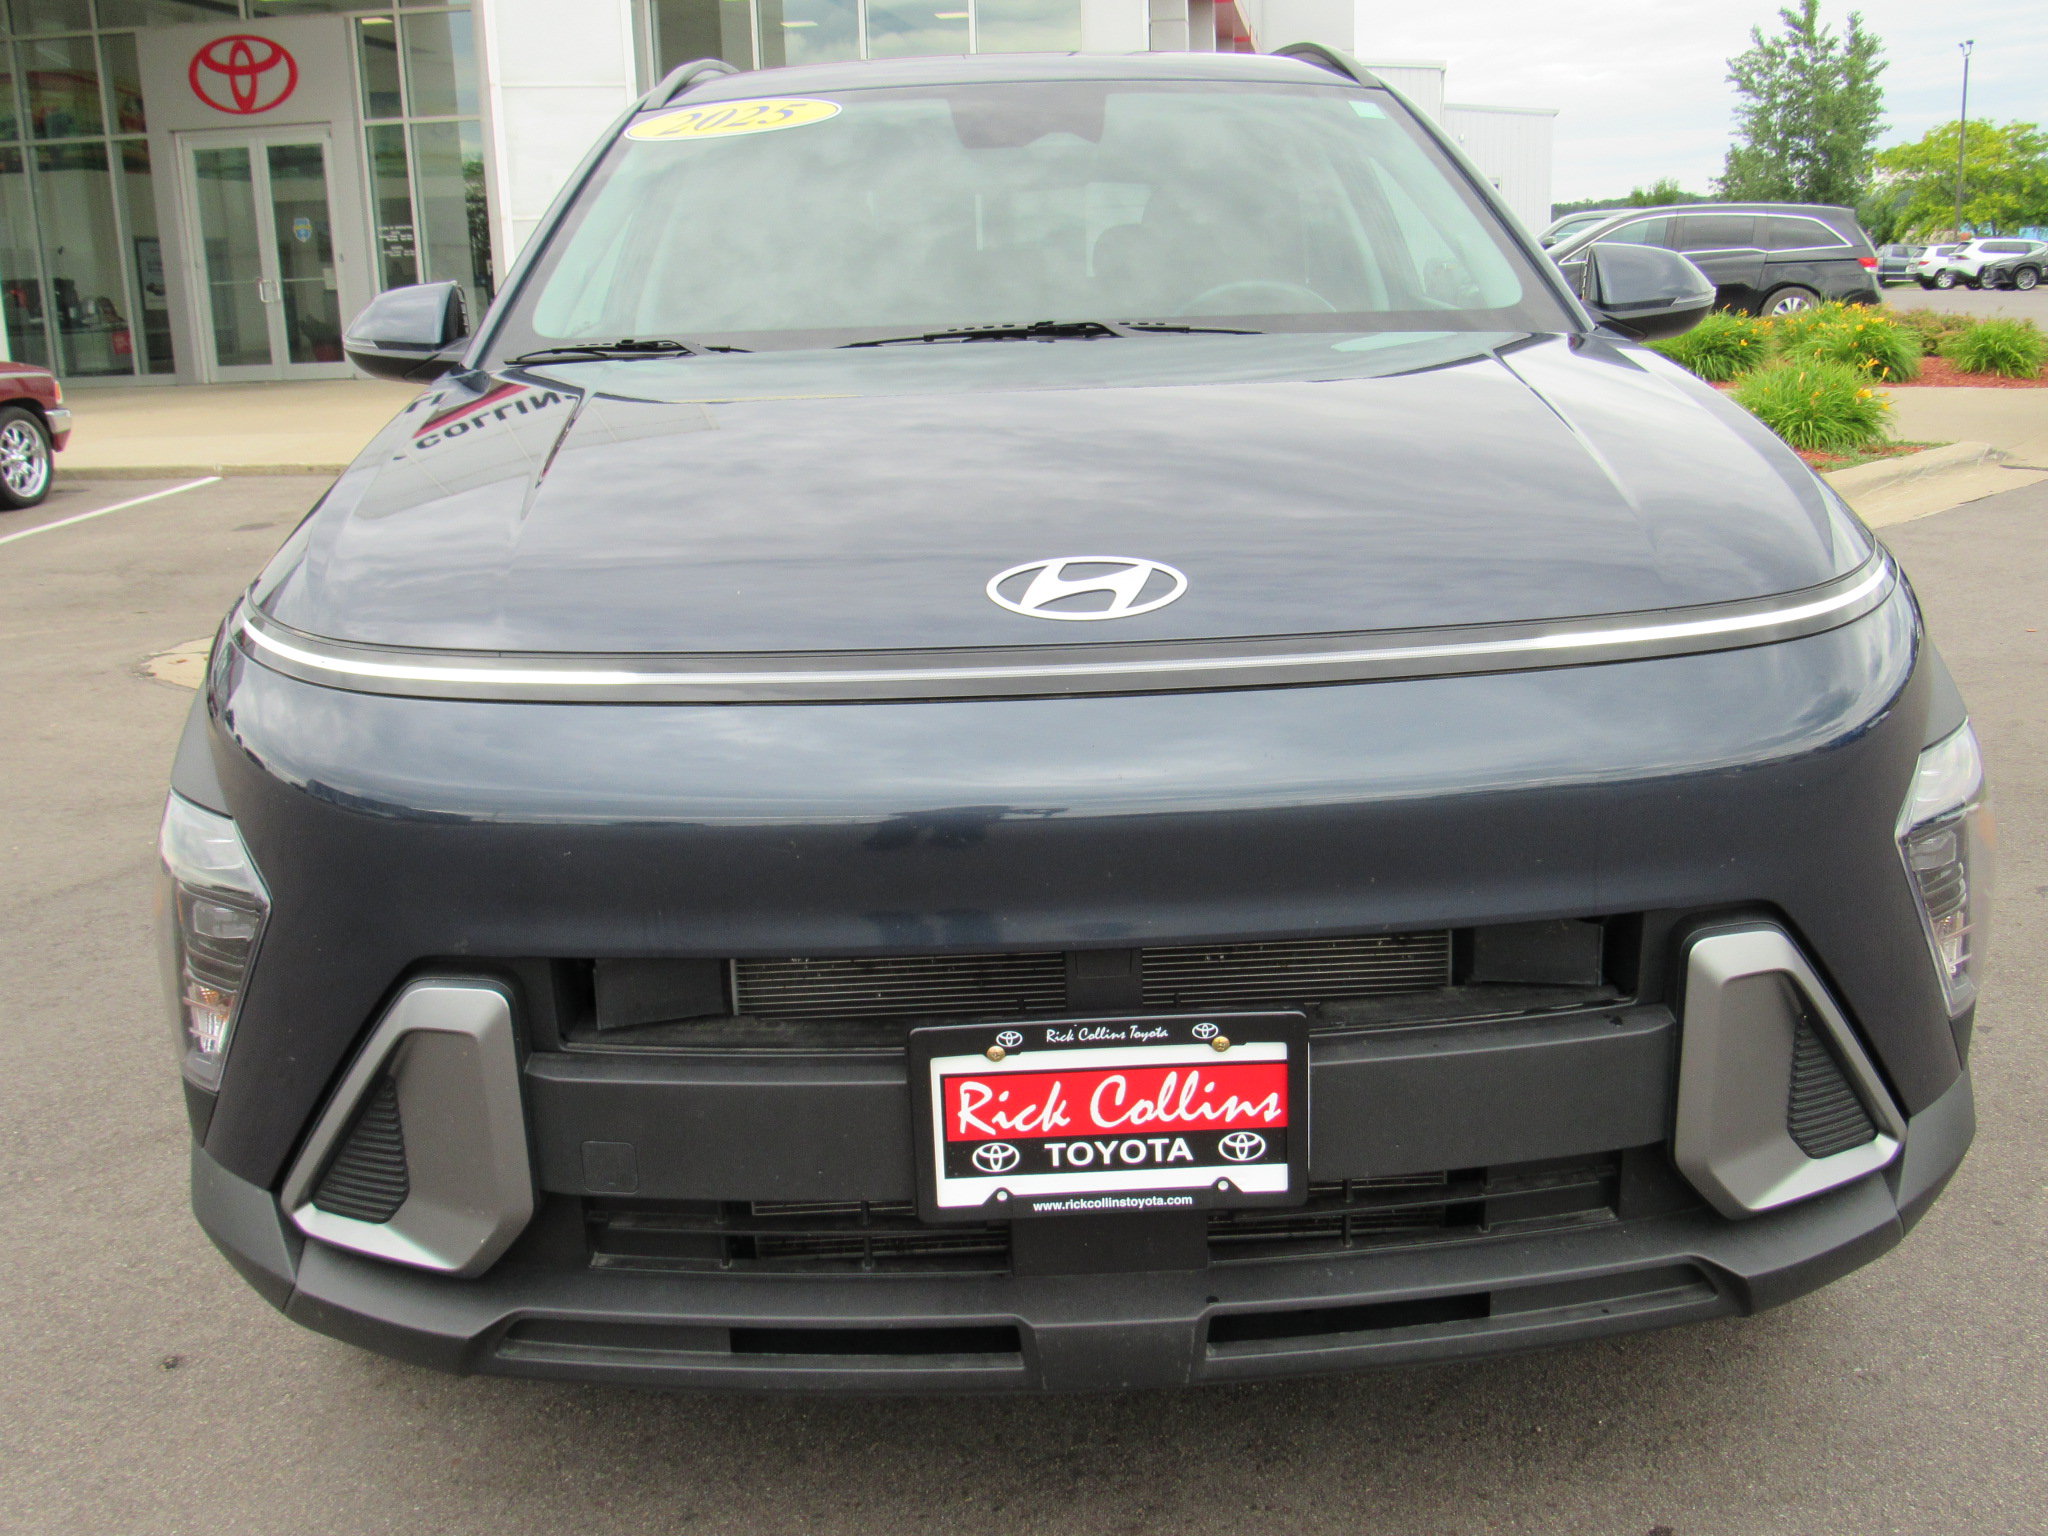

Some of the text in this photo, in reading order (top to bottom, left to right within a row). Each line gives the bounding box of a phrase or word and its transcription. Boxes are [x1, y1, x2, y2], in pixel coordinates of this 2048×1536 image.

[654, 104, 808, 137] 2025
[1046, 1024, 1169, 1043] Rick Collins Toyota
[958, 1069, 1281, 1136] Rick Collins
[1044, 1137, 1194, 1168] TOYOTA
[1032, 1195, 1193, 1212] www.rickcollinstoyota.com
